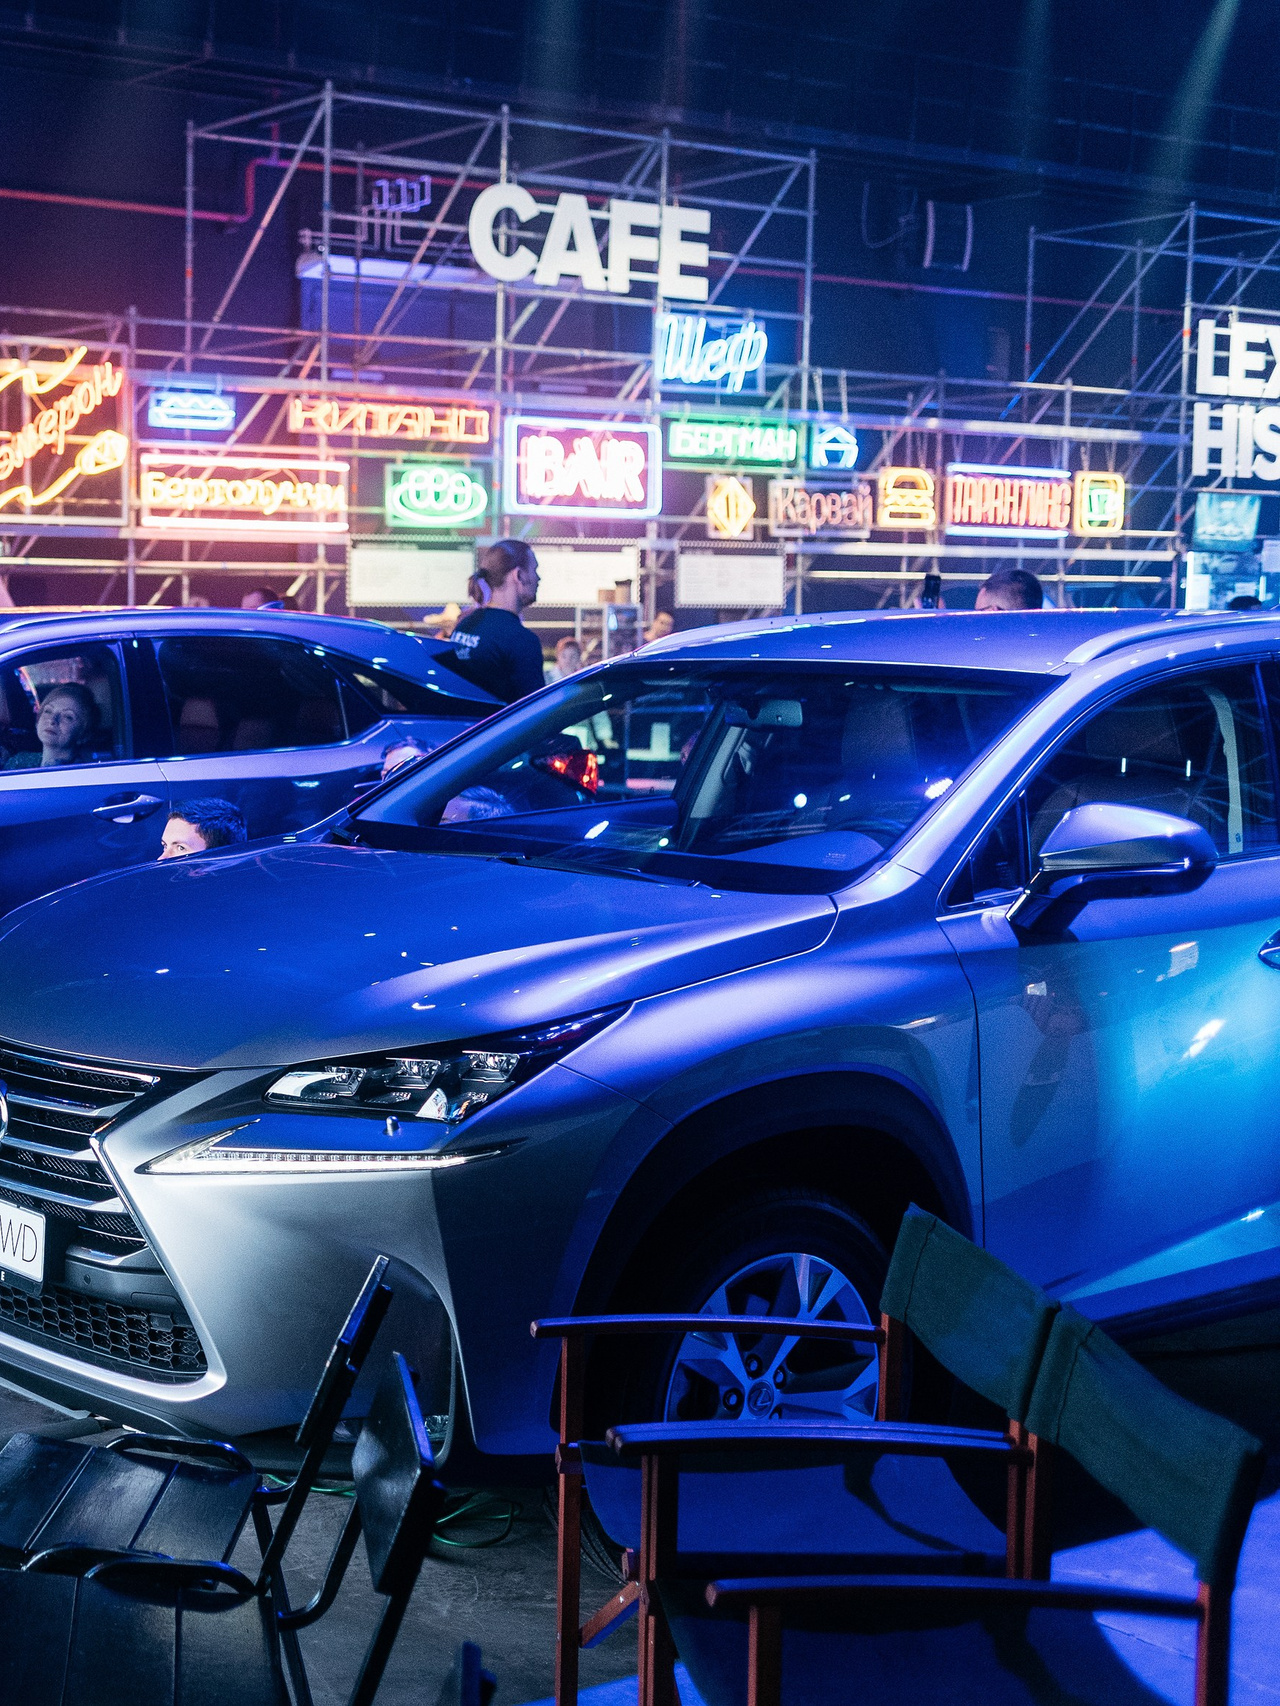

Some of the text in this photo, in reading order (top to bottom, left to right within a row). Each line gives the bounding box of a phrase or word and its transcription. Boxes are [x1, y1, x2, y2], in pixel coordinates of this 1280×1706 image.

[469, 183, 711, 301] CAFE
[658, 314, 768, 393] Шеф
[290, 399, 490, 443] КИТАНО
[673, 425, 798, 461] БЕРГМАН
[142, 471, 349, 515] Бертолуччи
[523, 435, 646, 502] BAR
